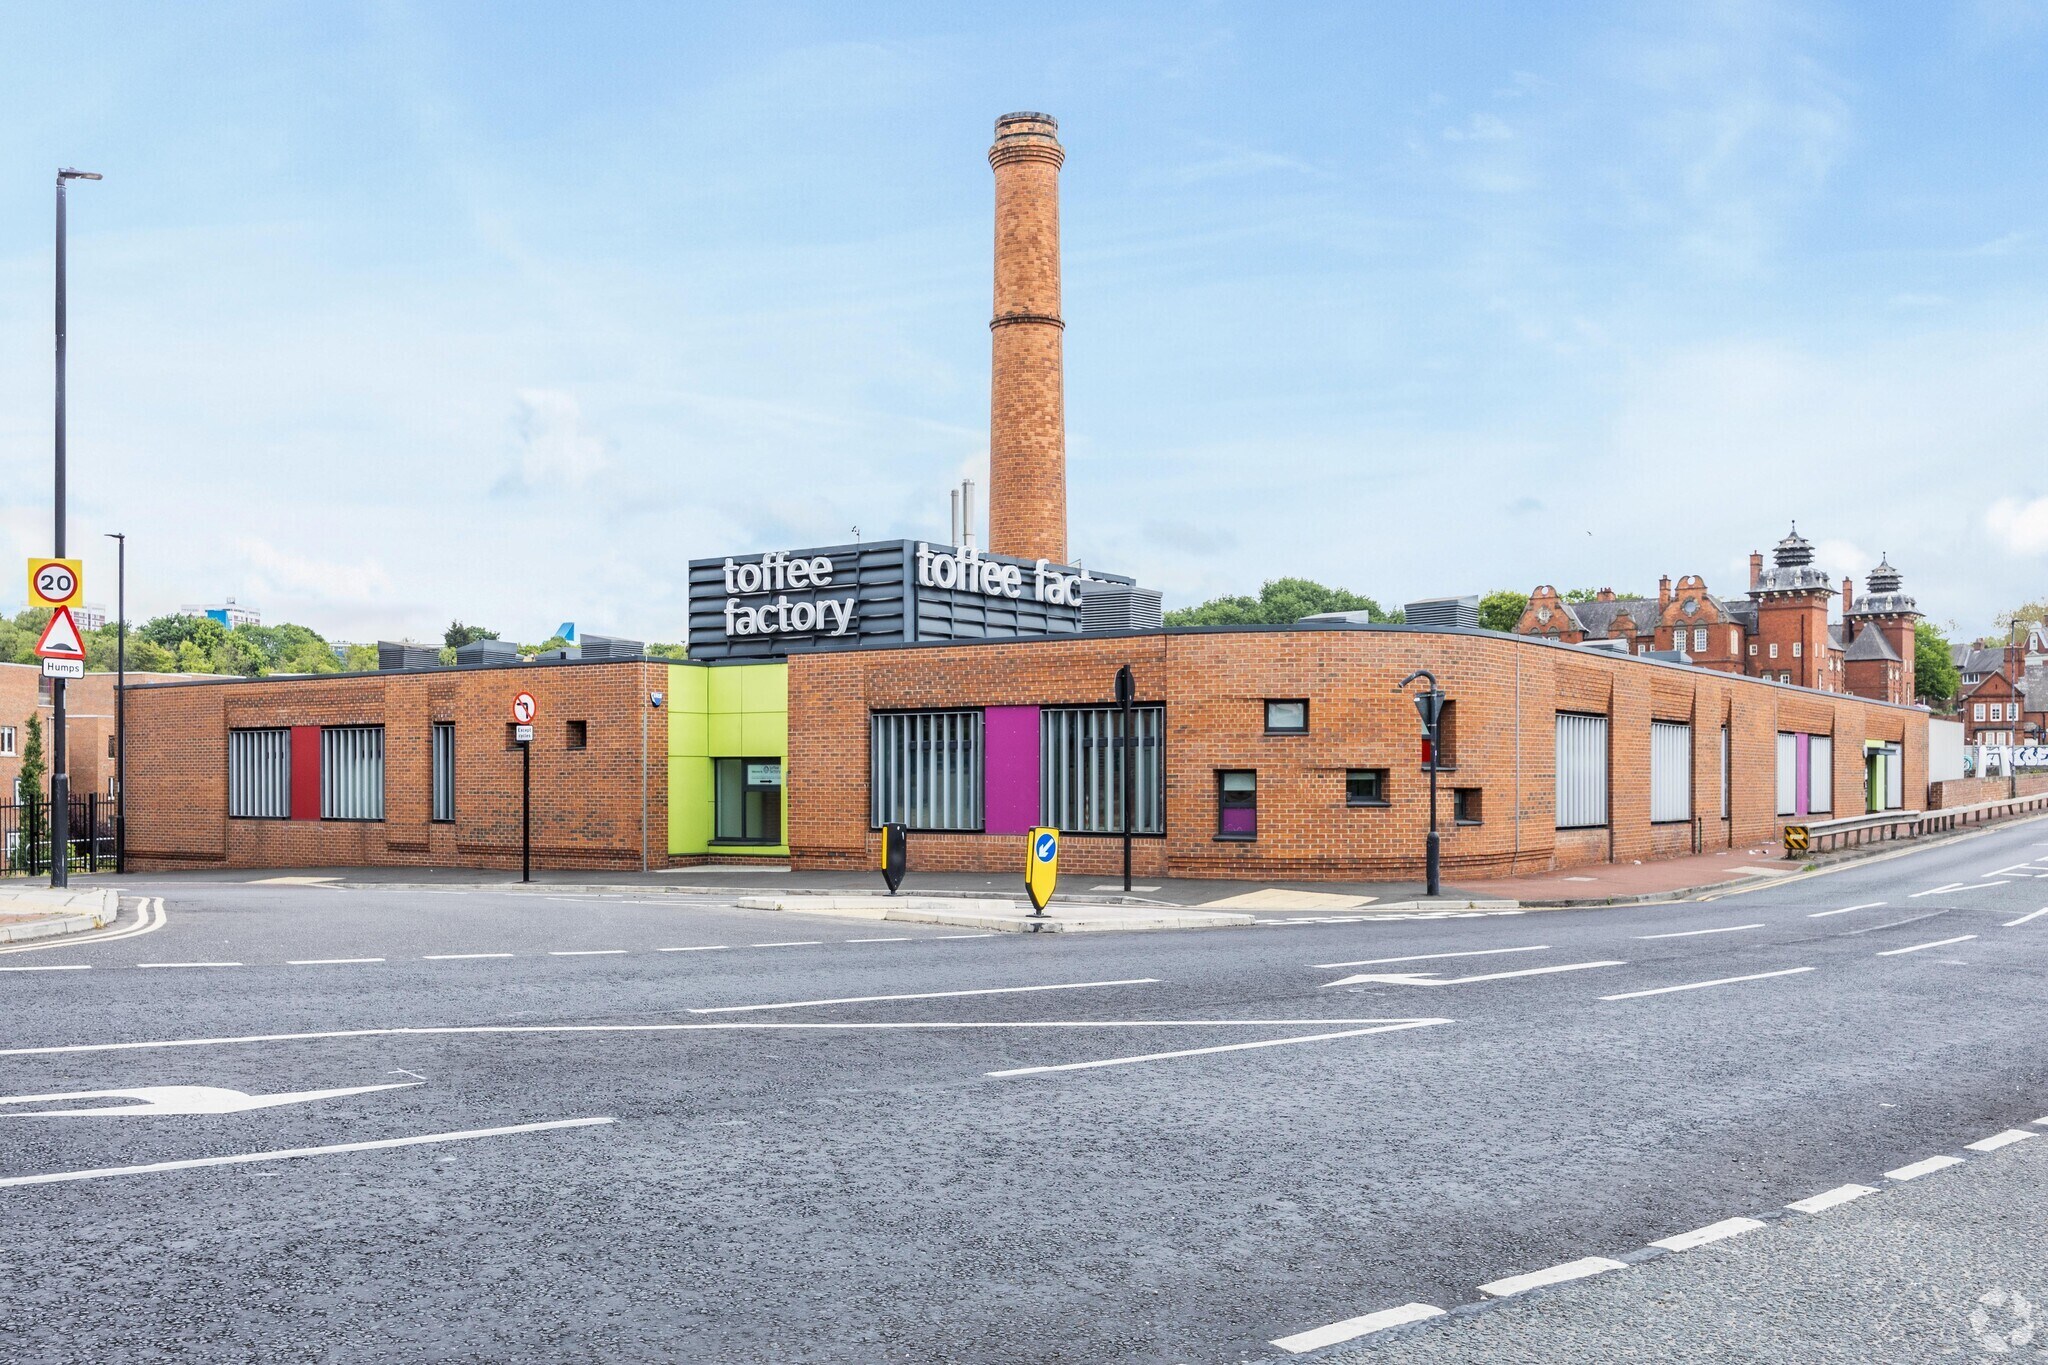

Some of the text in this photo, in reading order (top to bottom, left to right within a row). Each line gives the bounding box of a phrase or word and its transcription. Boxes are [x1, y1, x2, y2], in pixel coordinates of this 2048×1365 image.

[41, 574, 72, 591] 20
[723, 551, 834, 594] toffee
[916, 542, 1022, 599] toffee
[724, 595, 855, 636] factory
[47, 662, 80, 673] Humps
